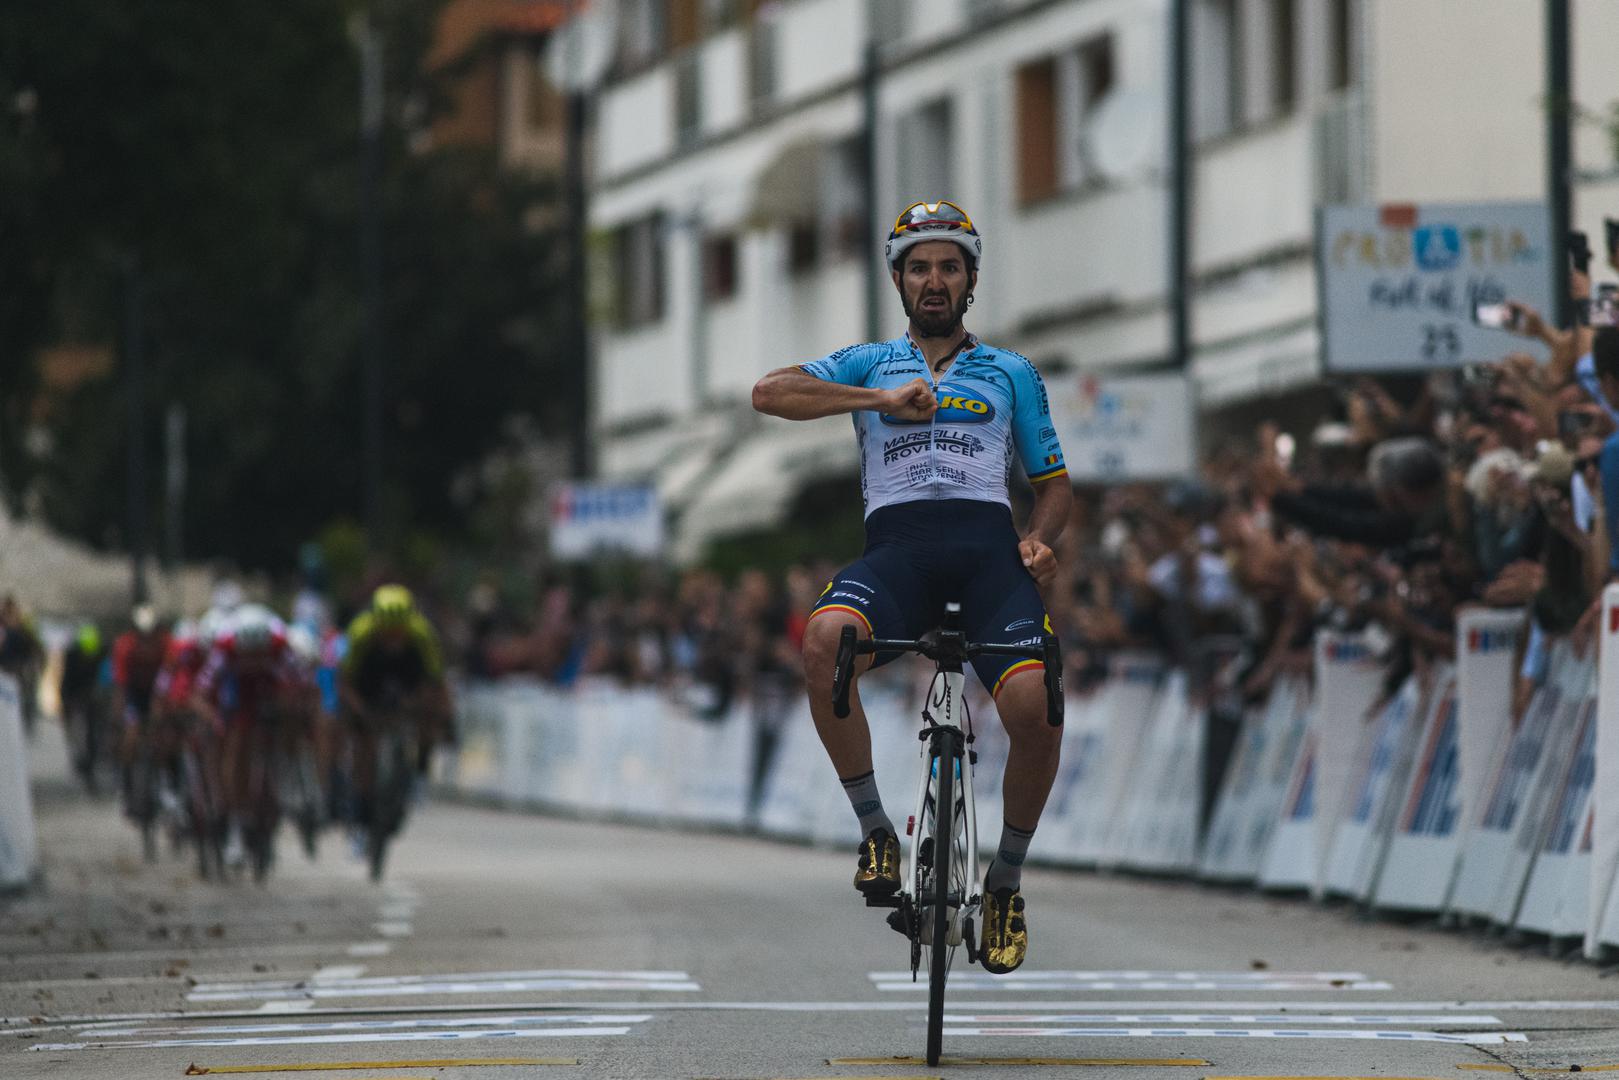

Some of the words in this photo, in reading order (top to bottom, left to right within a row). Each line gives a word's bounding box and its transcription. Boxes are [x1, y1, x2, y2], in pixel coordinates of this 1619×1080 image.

[883, 368, 924, 376] LOOK
[941, 396, 988, 414] KO
[1039, 384, 1049, 415] SUD
[884, 429, 973, 451] MARSEILLE
[884, 442, 970, 466] PROVENCE
[910, 466, 966, 477] MARSEILLE
